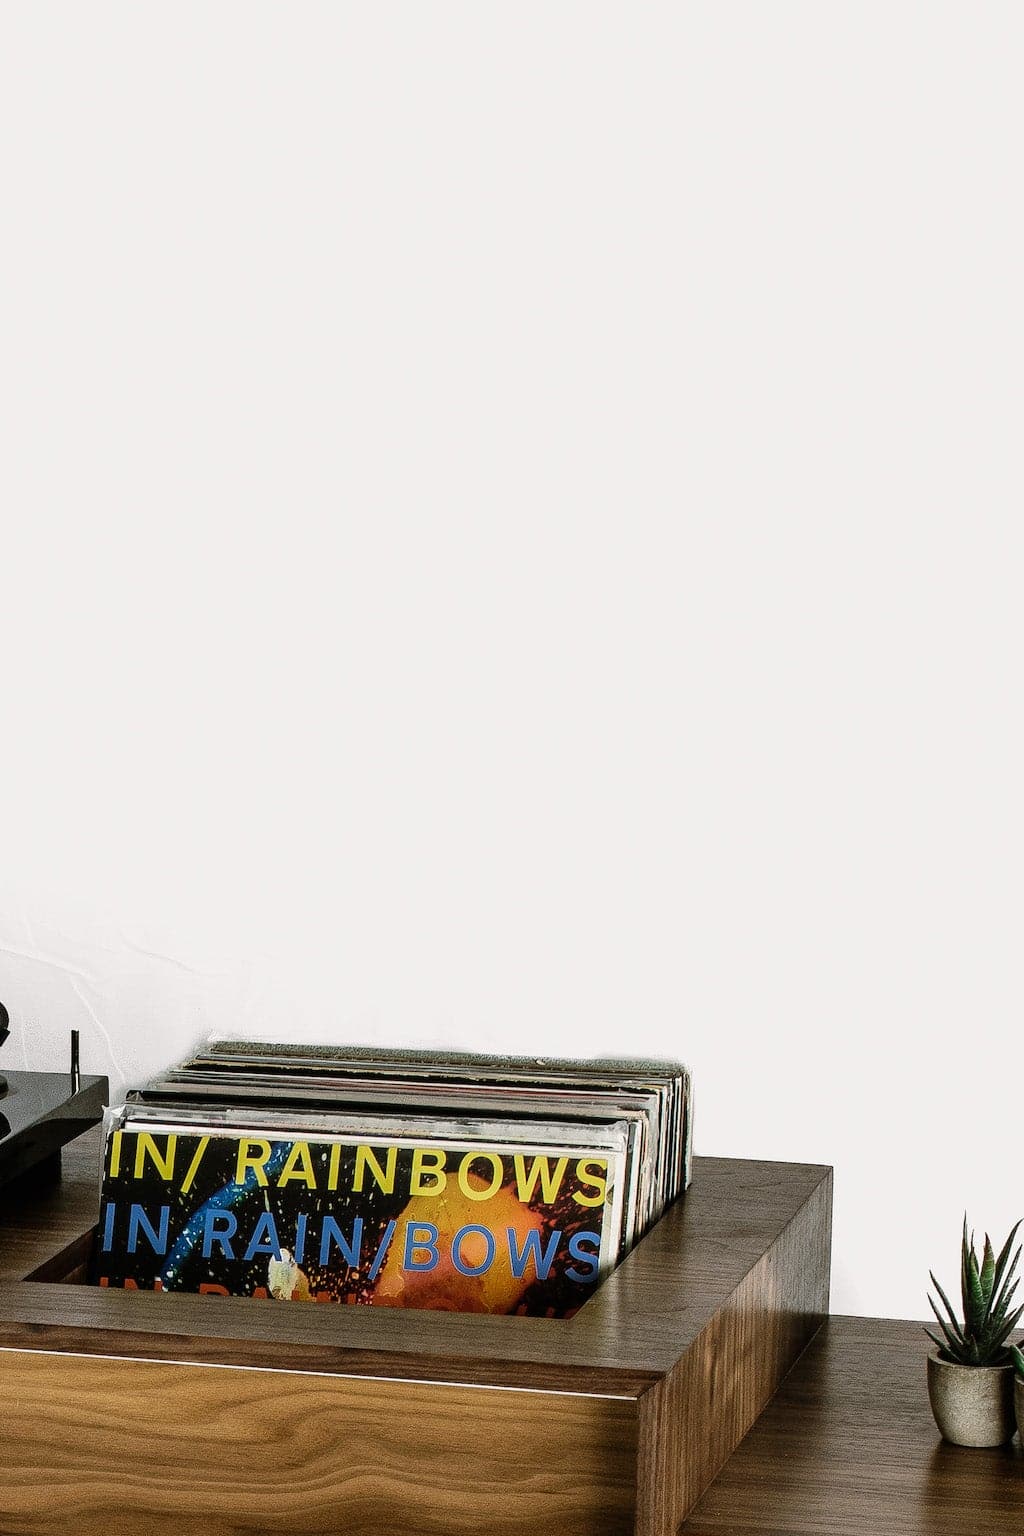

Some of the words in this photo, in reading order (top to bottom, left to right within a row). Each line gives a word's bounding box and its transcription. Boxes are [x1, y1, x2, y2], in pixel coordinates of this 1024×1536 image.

[109, 1131, 208, 1194] IN/
[235, 1134, 609, 1206] RAINBOWS
[102, 1203, 171, 1254] IN
[202, 1209, 602, 1284] RAIN/BOWS
